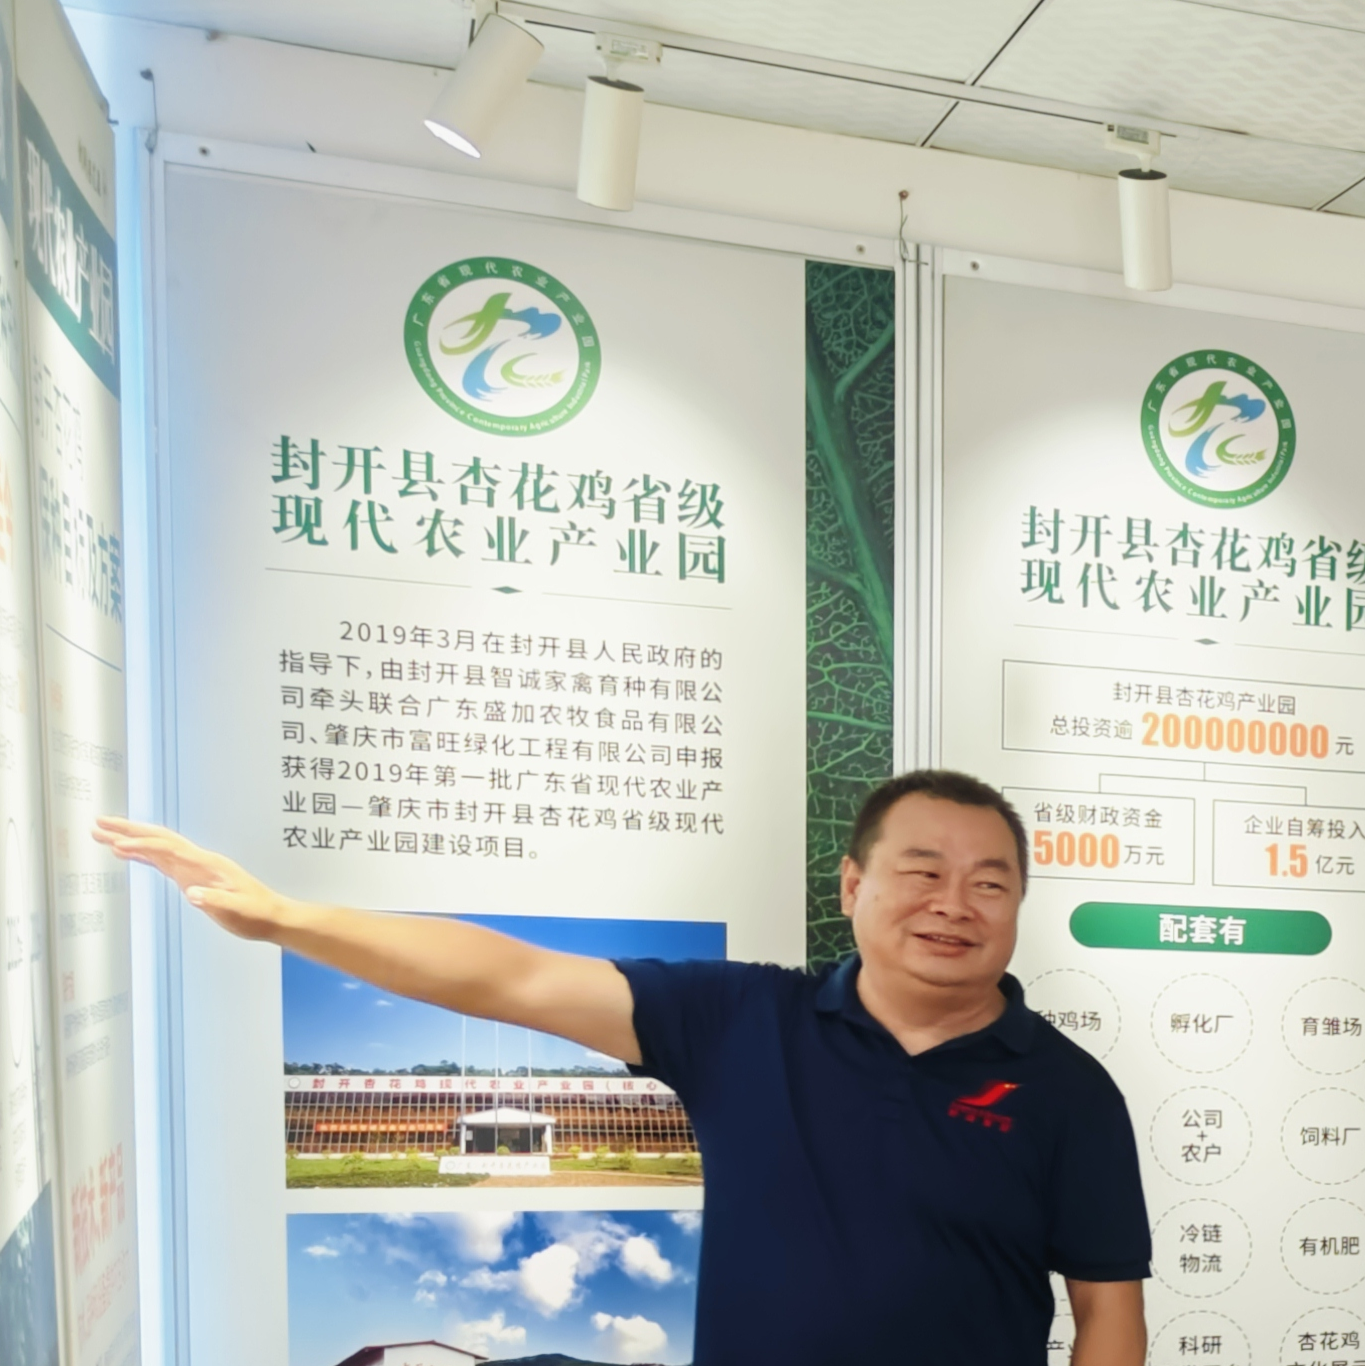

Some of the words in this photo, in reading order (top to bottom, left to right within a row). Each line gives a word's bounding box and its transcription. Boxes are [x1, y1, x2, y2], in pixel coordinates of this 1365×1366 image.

[412, 260, 596, 348] 广东省现代农业产业园
[1147, 353, 1292, 430] 广东省现代农业产业园
[466, 411, 528, 433] Contemporary
[270, 433, 726, 531] 封开县杏花鸡省级
[271, 493, 727, 585] 现代农业产业园
[338, 620, 724, 673] 2019年3月在封开县人民政府的
[278, 648, 724, 705] 指导下，由封开县智诚家禽育种有限公
[280, 684, 724, 737] 司牵头联合广东盛加农牧食品有限公
[1111, 682, 1297, 716] 封开县杏花鸡产业园
[281, 719, 724, 771] 司、肇庆市富旺绿化工程有限公司申报
[281, 754, 725, 803] 获得2019年第一批广东省现代农业产
[1033, 801, 1164, 830] 省级财政资金
[282, 826, 540, 861] 农业产业园建设项目。
[1032, 829, 1166, 869] 5000万元
[1264, 843, 1356, 878] 1.5亿元
[1158, 912, 1248, 946] 配套有
[1169, 1012, 1235, 1035] 孵化厂
[1300, 1015, 1363, 1038] 育雏场
[1181, 1108, 1223, 1130] 公司
[1180, 1142, 1222, 1164] 农户
[1299, 1126, 1362, 1148] 饲料厂
[1179, 1222, 1223, 1245] 冷链
[1298, 1235, 1361, 1257] 有机肥
[1179, 1252, 1223, 1275] 物流
[1177, 1334, 1223, 1356] 科研
[1297, 1330, 1361, 1353] 杏花鸡
